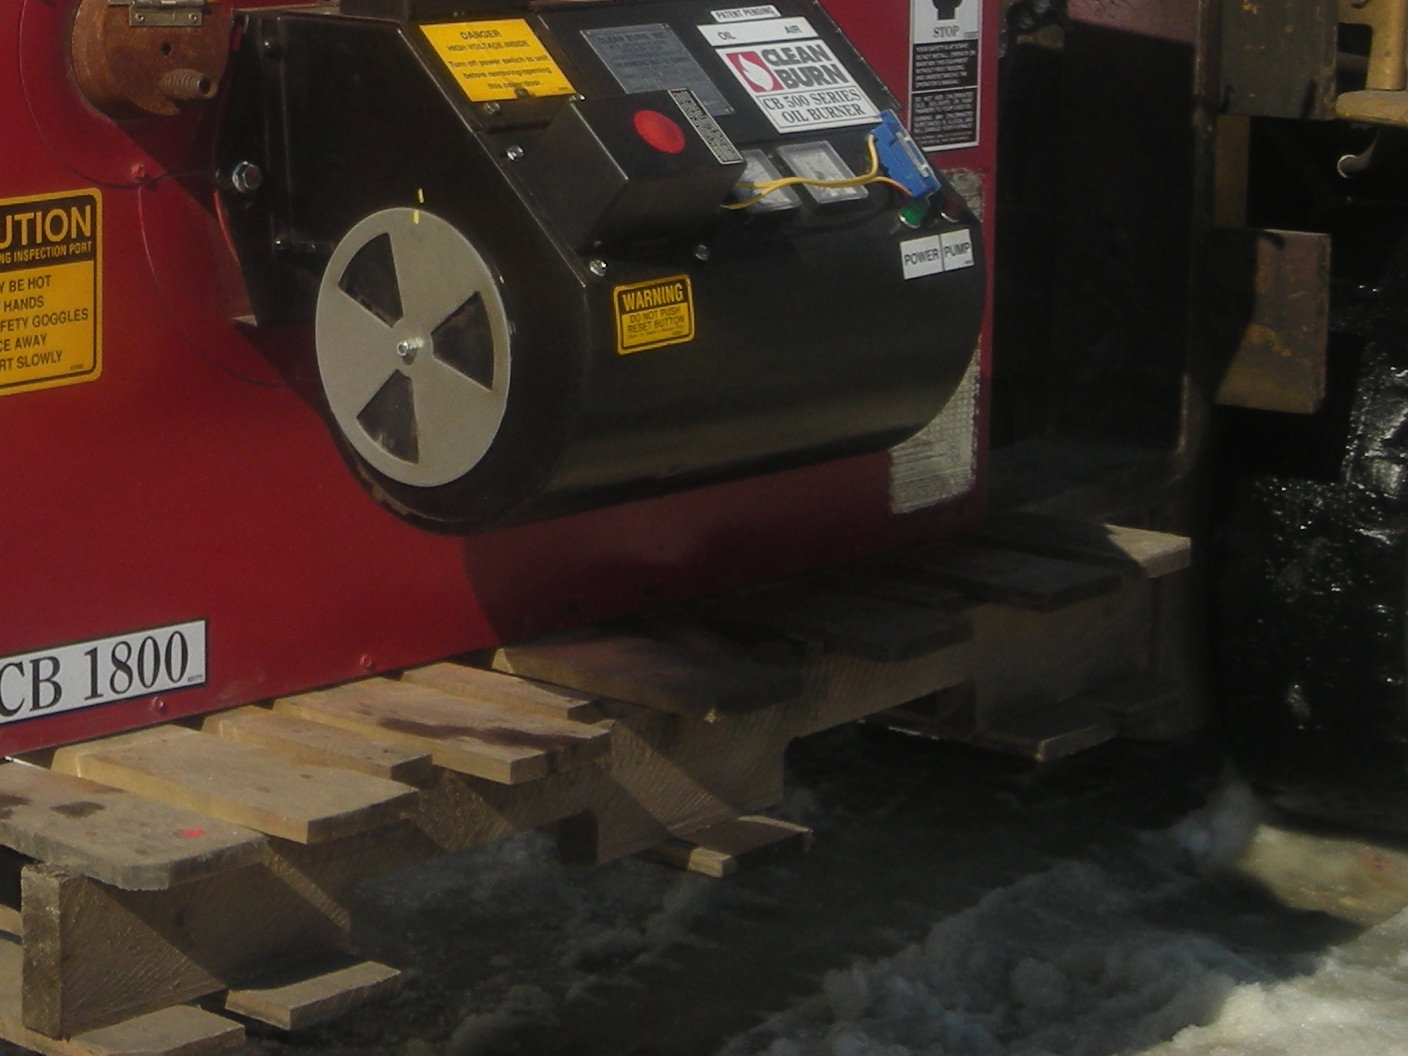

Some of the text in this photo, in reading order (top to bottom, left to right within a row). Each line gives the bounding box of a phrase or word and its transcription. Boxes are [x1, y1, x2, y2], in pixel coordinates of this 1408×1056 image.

[716, 7, 776, 19] PATENT PENDING
[460, 29, 502, 40] DANGER
[718, 25, 801, 40] OIL AIR
[933, 25, 960, 38] STOP
[762, 44, 832, 66] CLEAN
[774, 63, 849, 89] BURN
[763, 89, 861, 110] CB 500 SERIES
[782, 104, 866, 124] OIL BURNER
[14, 245, 67, 262] INSPECTION
[69, 241, 92, 256] PORT
[904, 242, 970, 264] POWER PUMP
[9, 278, 24, 292] BE
[28, 274, 52, 290] HOT
[4, 296, 44, 312] HANDS
[622, 283, 684, 311] WARNING
[32, 308, 88, 327] GOGGLES
[15, 333, 47, 349] AWAY
[17, 350, 62, 369] SLOWLY
[84, 630, 189, 701] 1800
